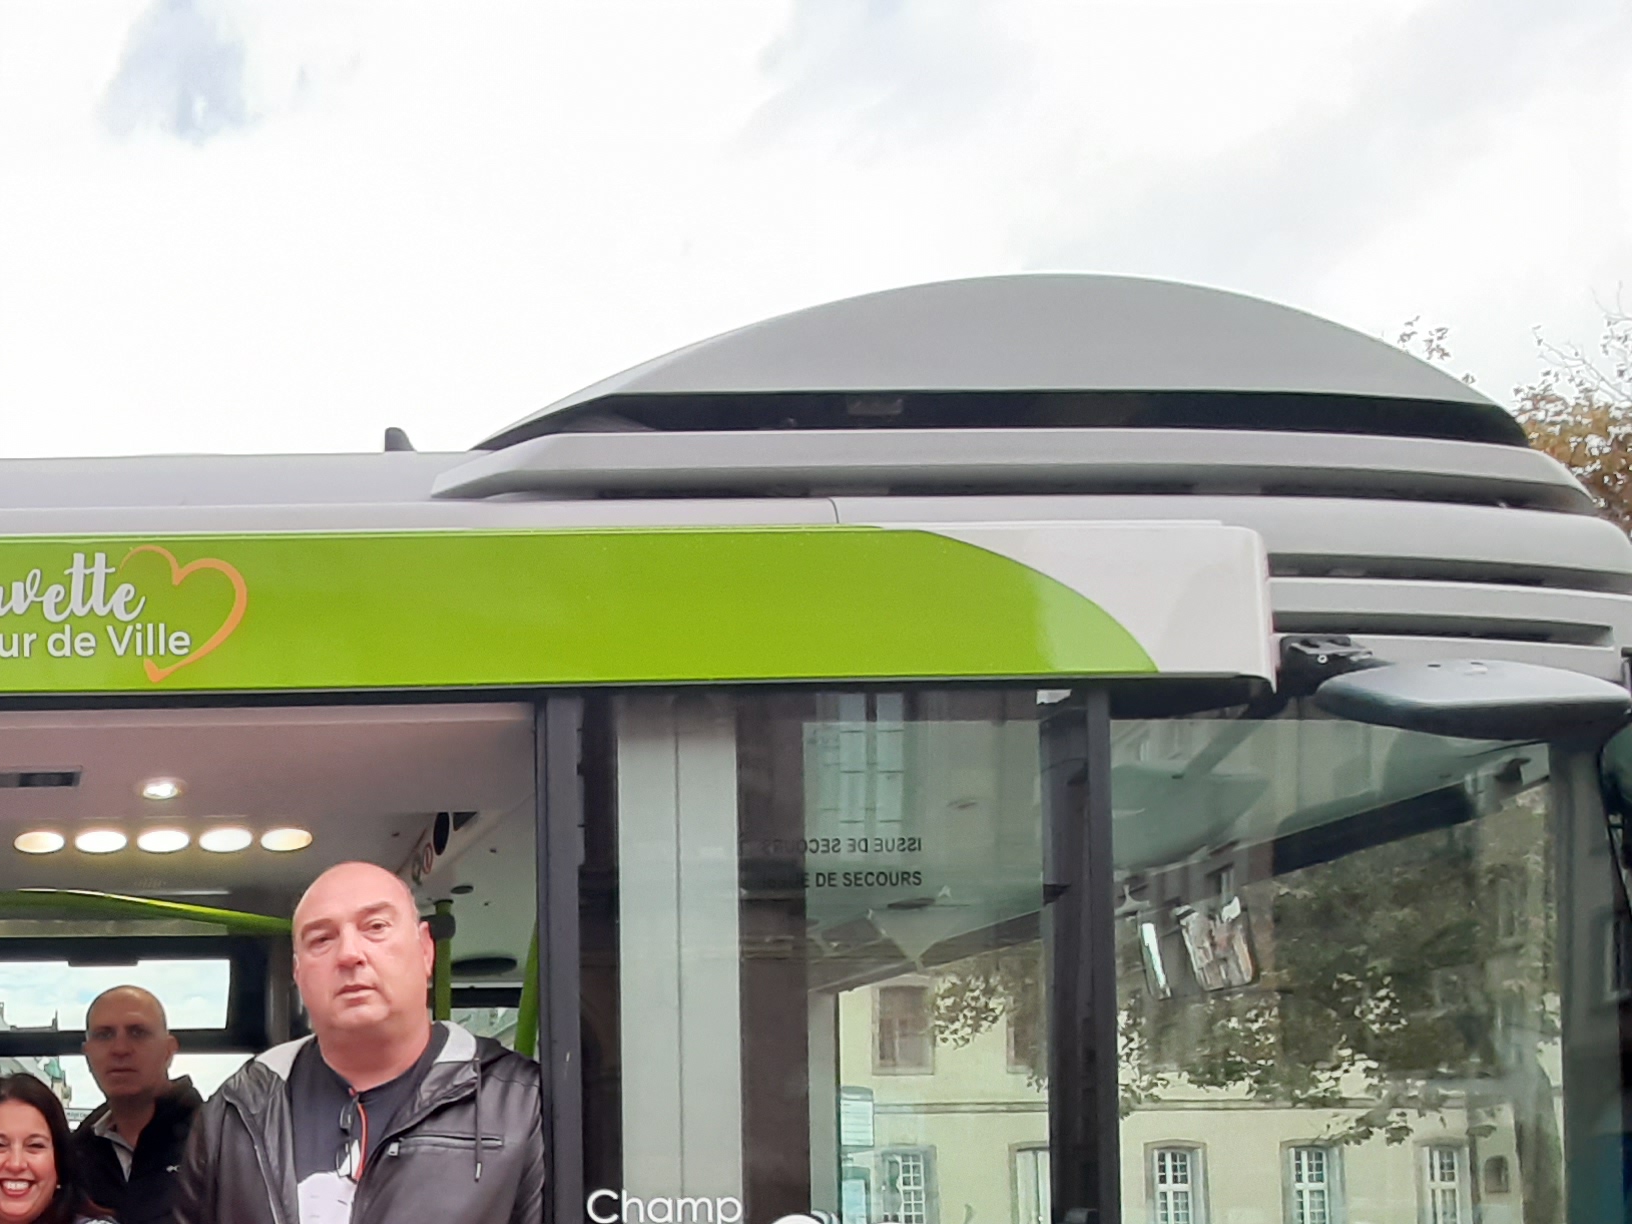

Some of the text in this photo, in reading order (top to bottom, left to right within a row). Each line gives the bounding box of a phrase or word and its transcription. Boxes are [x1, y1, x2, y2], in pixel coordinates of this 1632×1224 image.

[47, 624, 97, 658] de
[106, 622, 191, 657] Ville
[815, 871, 838, 888] DE
[842, 871, 923, 888] SECOURS
